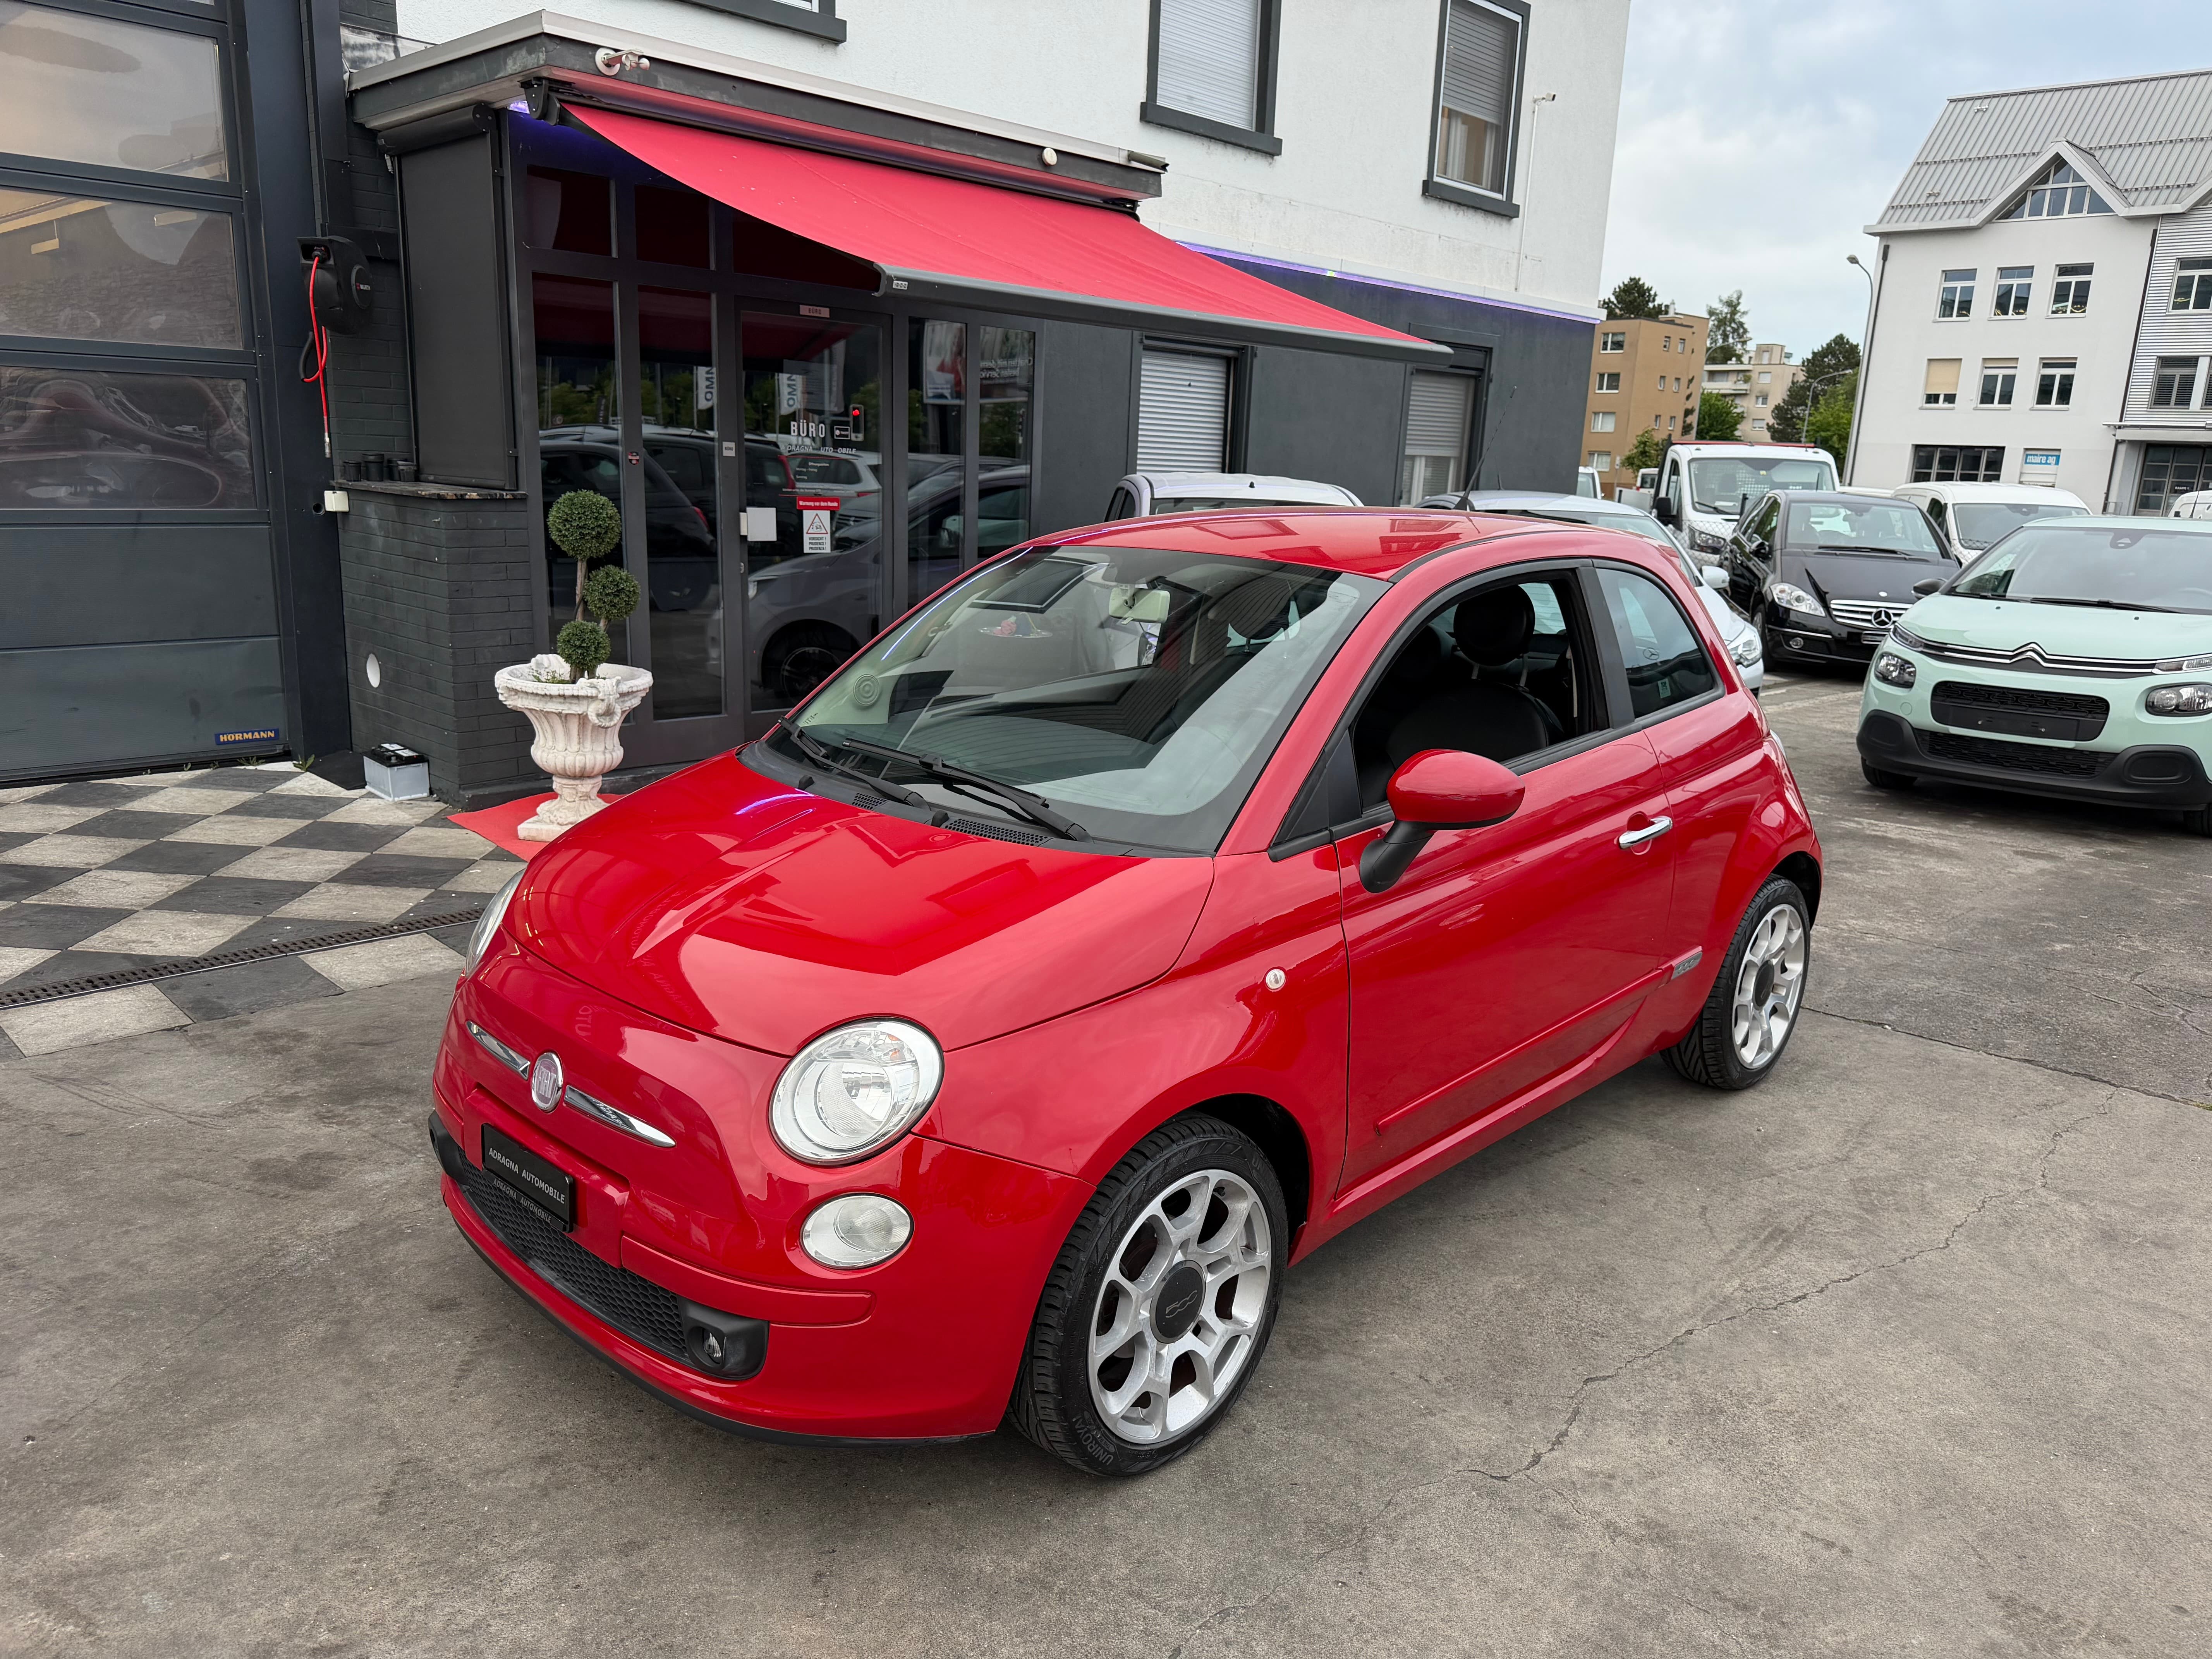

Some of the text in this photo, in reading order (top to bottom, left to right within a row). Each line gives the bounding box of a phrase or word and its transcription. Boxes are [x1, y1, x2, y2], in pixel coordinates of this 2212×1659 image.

[790, 420, 825, 438] BÜRO
[2027, 453, 2056, 465] maire ag
[220, 730, 275, 742] HÖRMANN
[538, 1066, 556, 1098] FIAT
[489, 1147, 565, 1204] ADRAGNA AUTOMOBILE
[1165, 1290, 1198, 1318] 500
